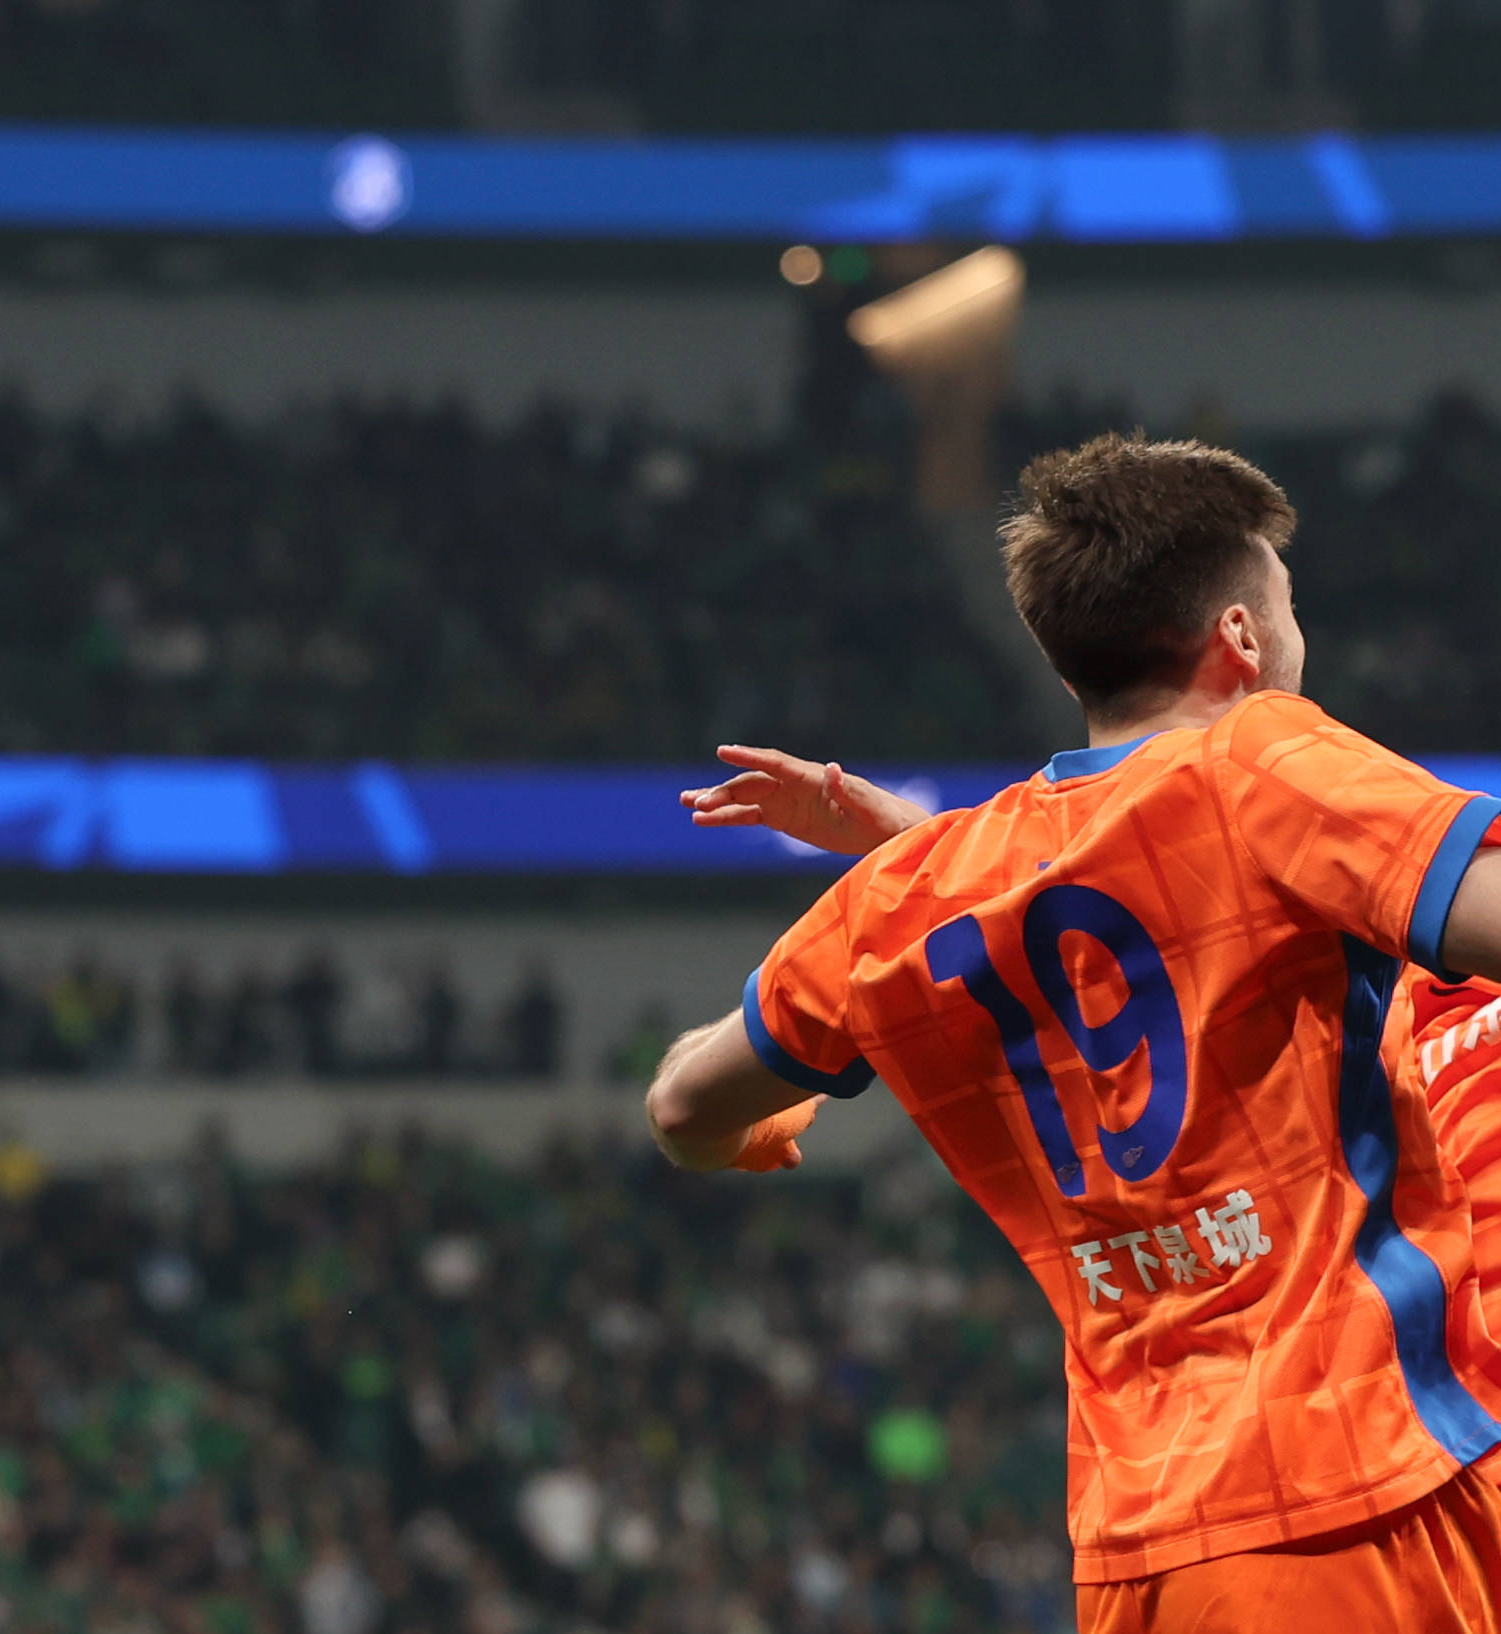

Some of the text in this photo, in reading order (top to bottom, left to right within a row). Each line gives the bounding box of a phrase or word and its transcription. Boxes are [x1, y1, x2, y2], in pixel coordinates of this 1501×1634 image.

[925, 884, 1188, 1197] 19
[1071, 1189, 1273, 1306] 天下泉城
